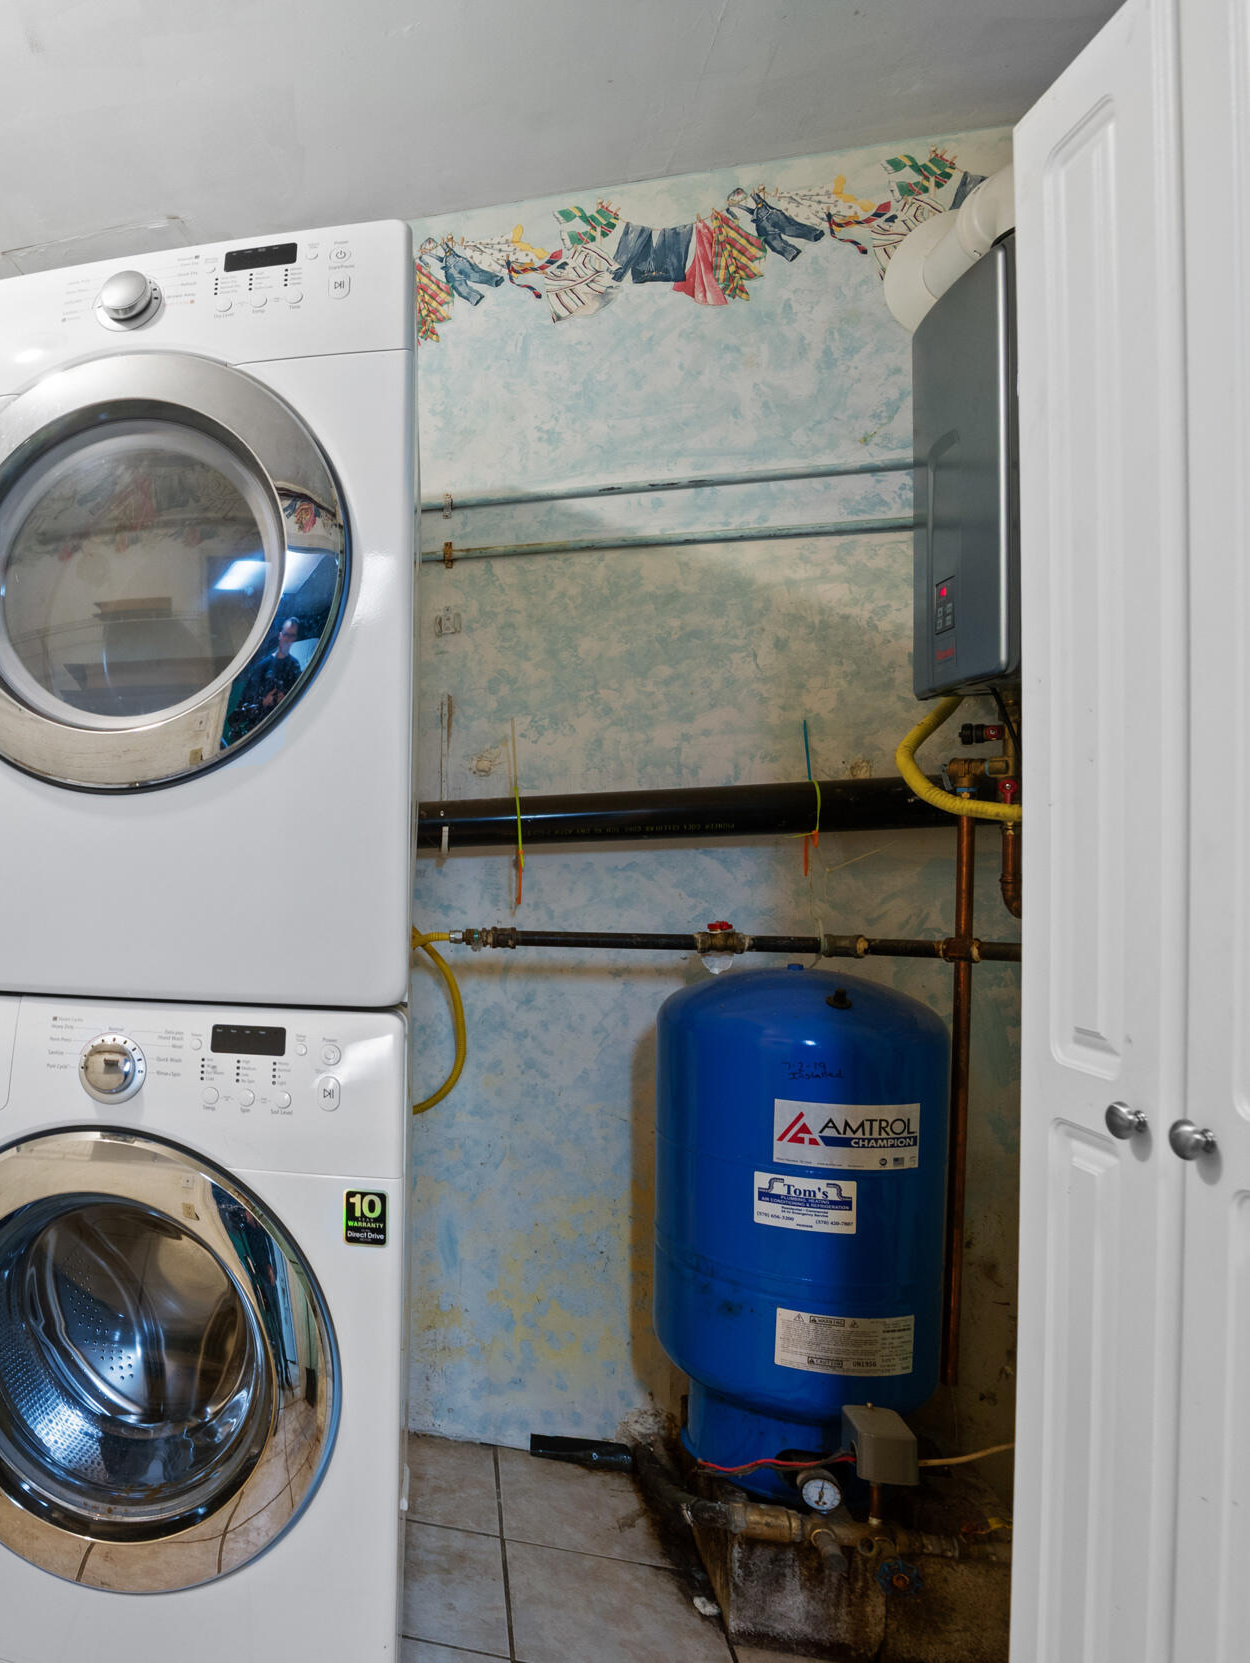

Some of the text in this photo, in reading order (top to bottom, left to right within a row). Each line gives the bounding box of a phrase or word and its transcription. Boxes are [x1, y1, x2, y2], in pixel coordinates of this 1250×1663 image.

[818, 1117, 916, 1136] AMTROL
[850, 1138, 914, 1148] CHAMPION
[783, 1183, 829, 1199] Tom's
[349, 1193, 382, 1218] 10
[347, 1220, 384, 1229] WARRANTY
[368, 1232, 385, 1240] Drive
